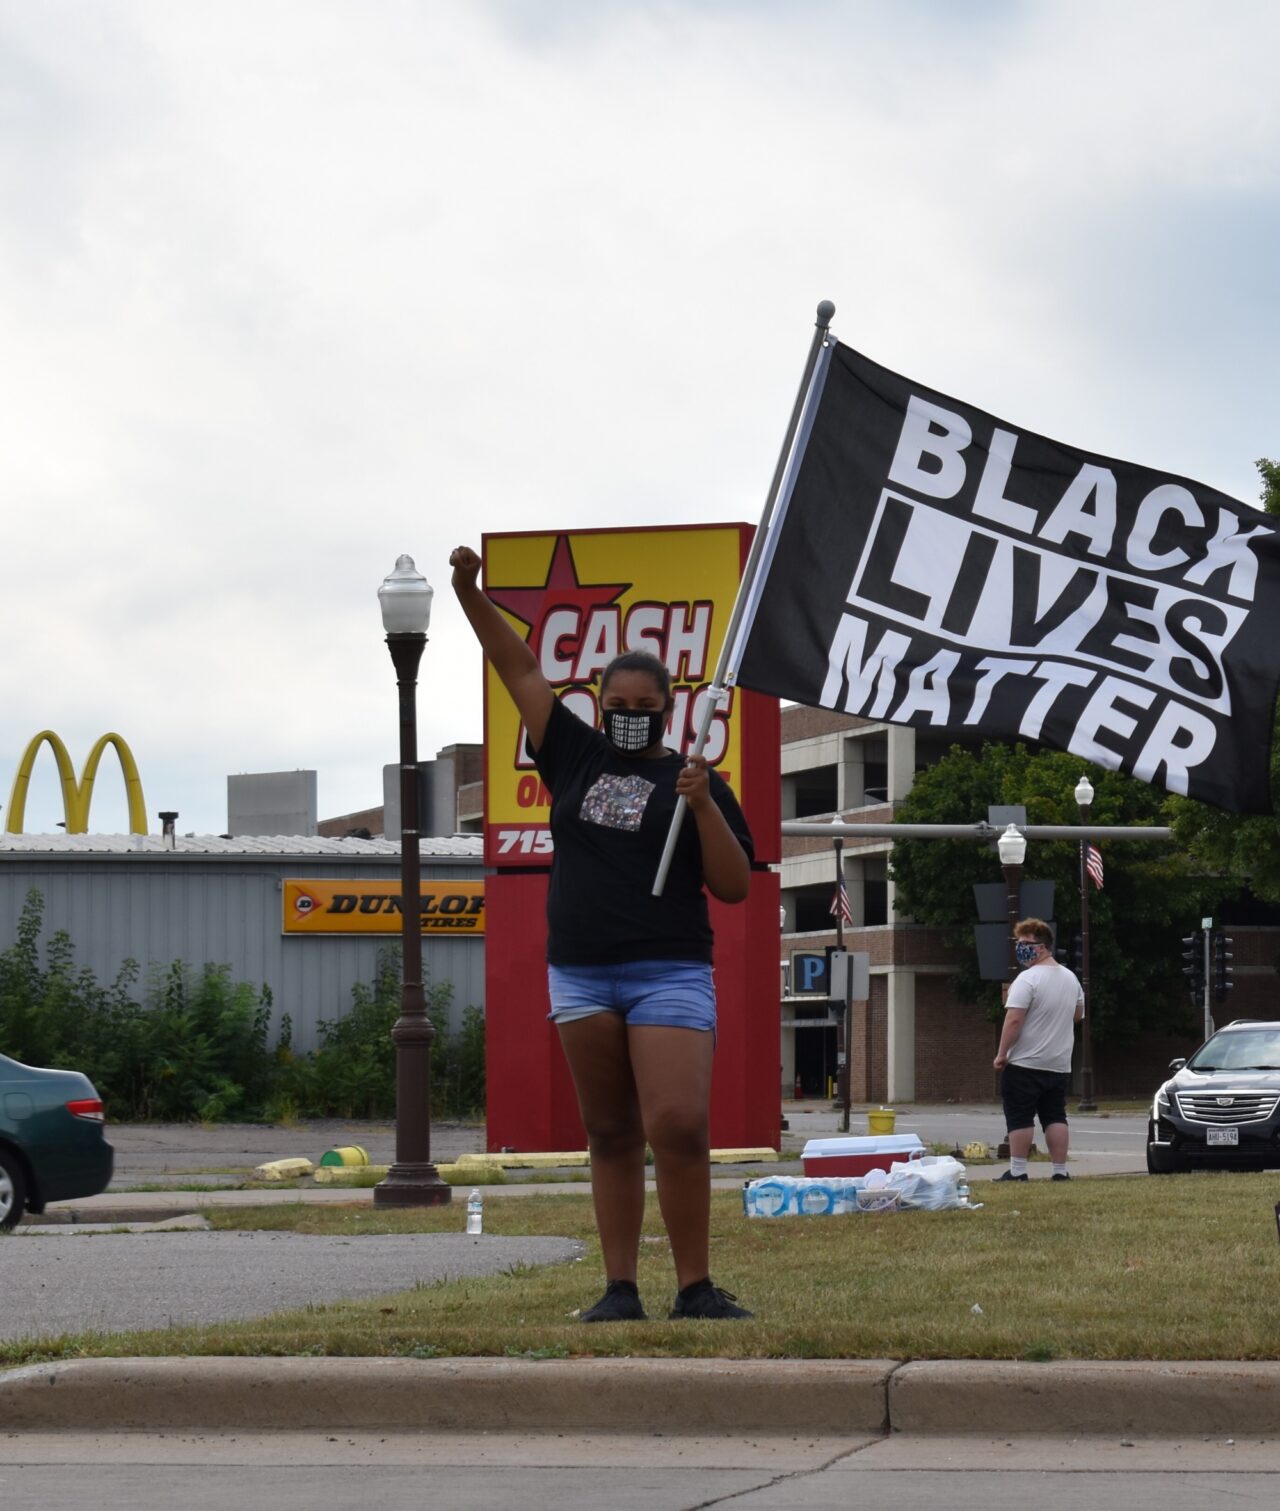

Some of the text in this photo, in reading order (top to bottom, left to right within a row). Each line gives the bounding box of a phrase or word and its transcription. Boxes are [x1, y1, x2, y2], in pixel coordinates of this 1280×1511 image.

[887, 393, 1276, 602] BLACK
[540, 602, 713, 686] CASH
[855, 494, 1231, 702] LIVES
[818, 611, 1217, 798] MATTER
[497, 829, 554, 854] 715
[802, 956, 826, 990] P
